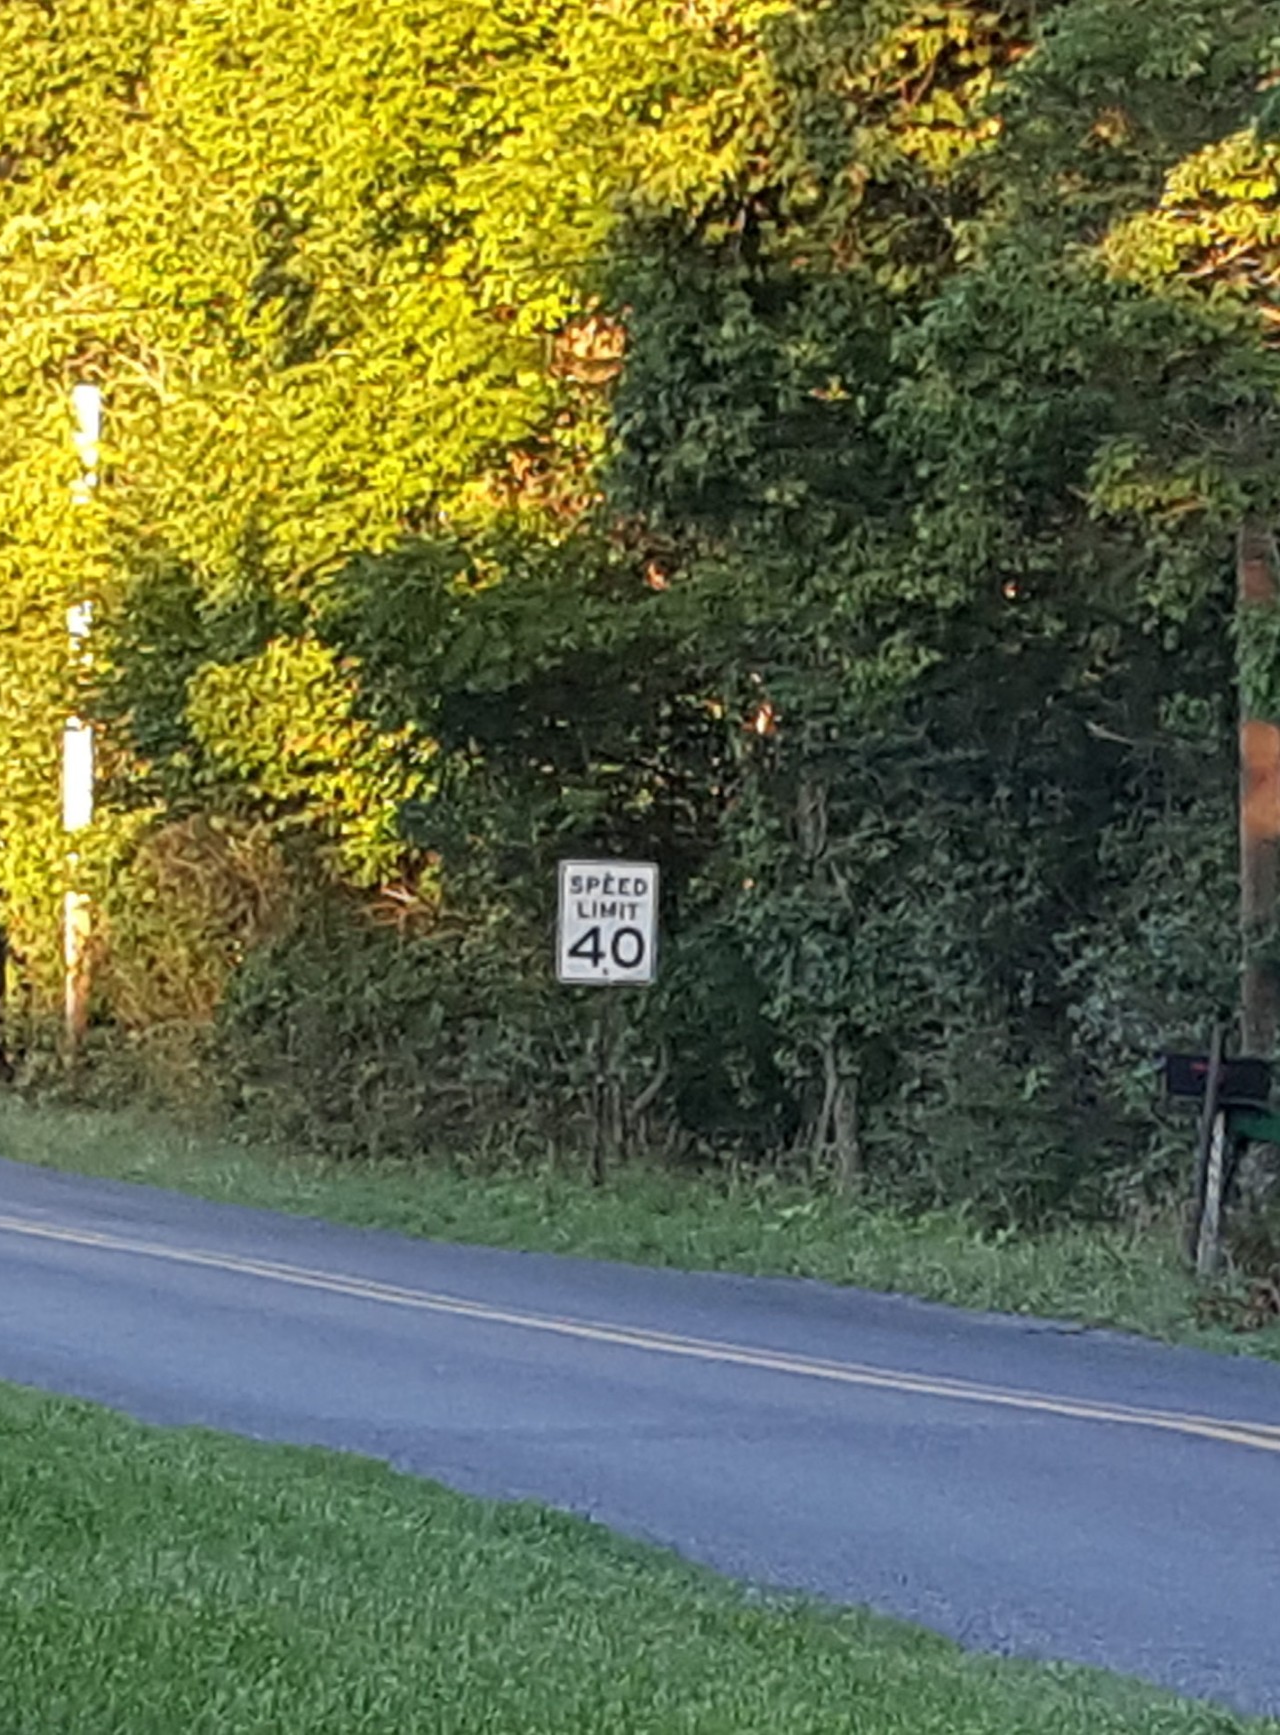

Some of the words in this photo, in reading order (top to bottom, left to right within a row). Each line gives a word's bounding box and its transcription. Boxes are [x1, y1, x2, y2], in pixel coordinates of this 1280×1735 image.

[570, 875, 648, 896] SPEED
[577, 901, 639, 920] LIMIT
[568, 925, 645, 969] 40
